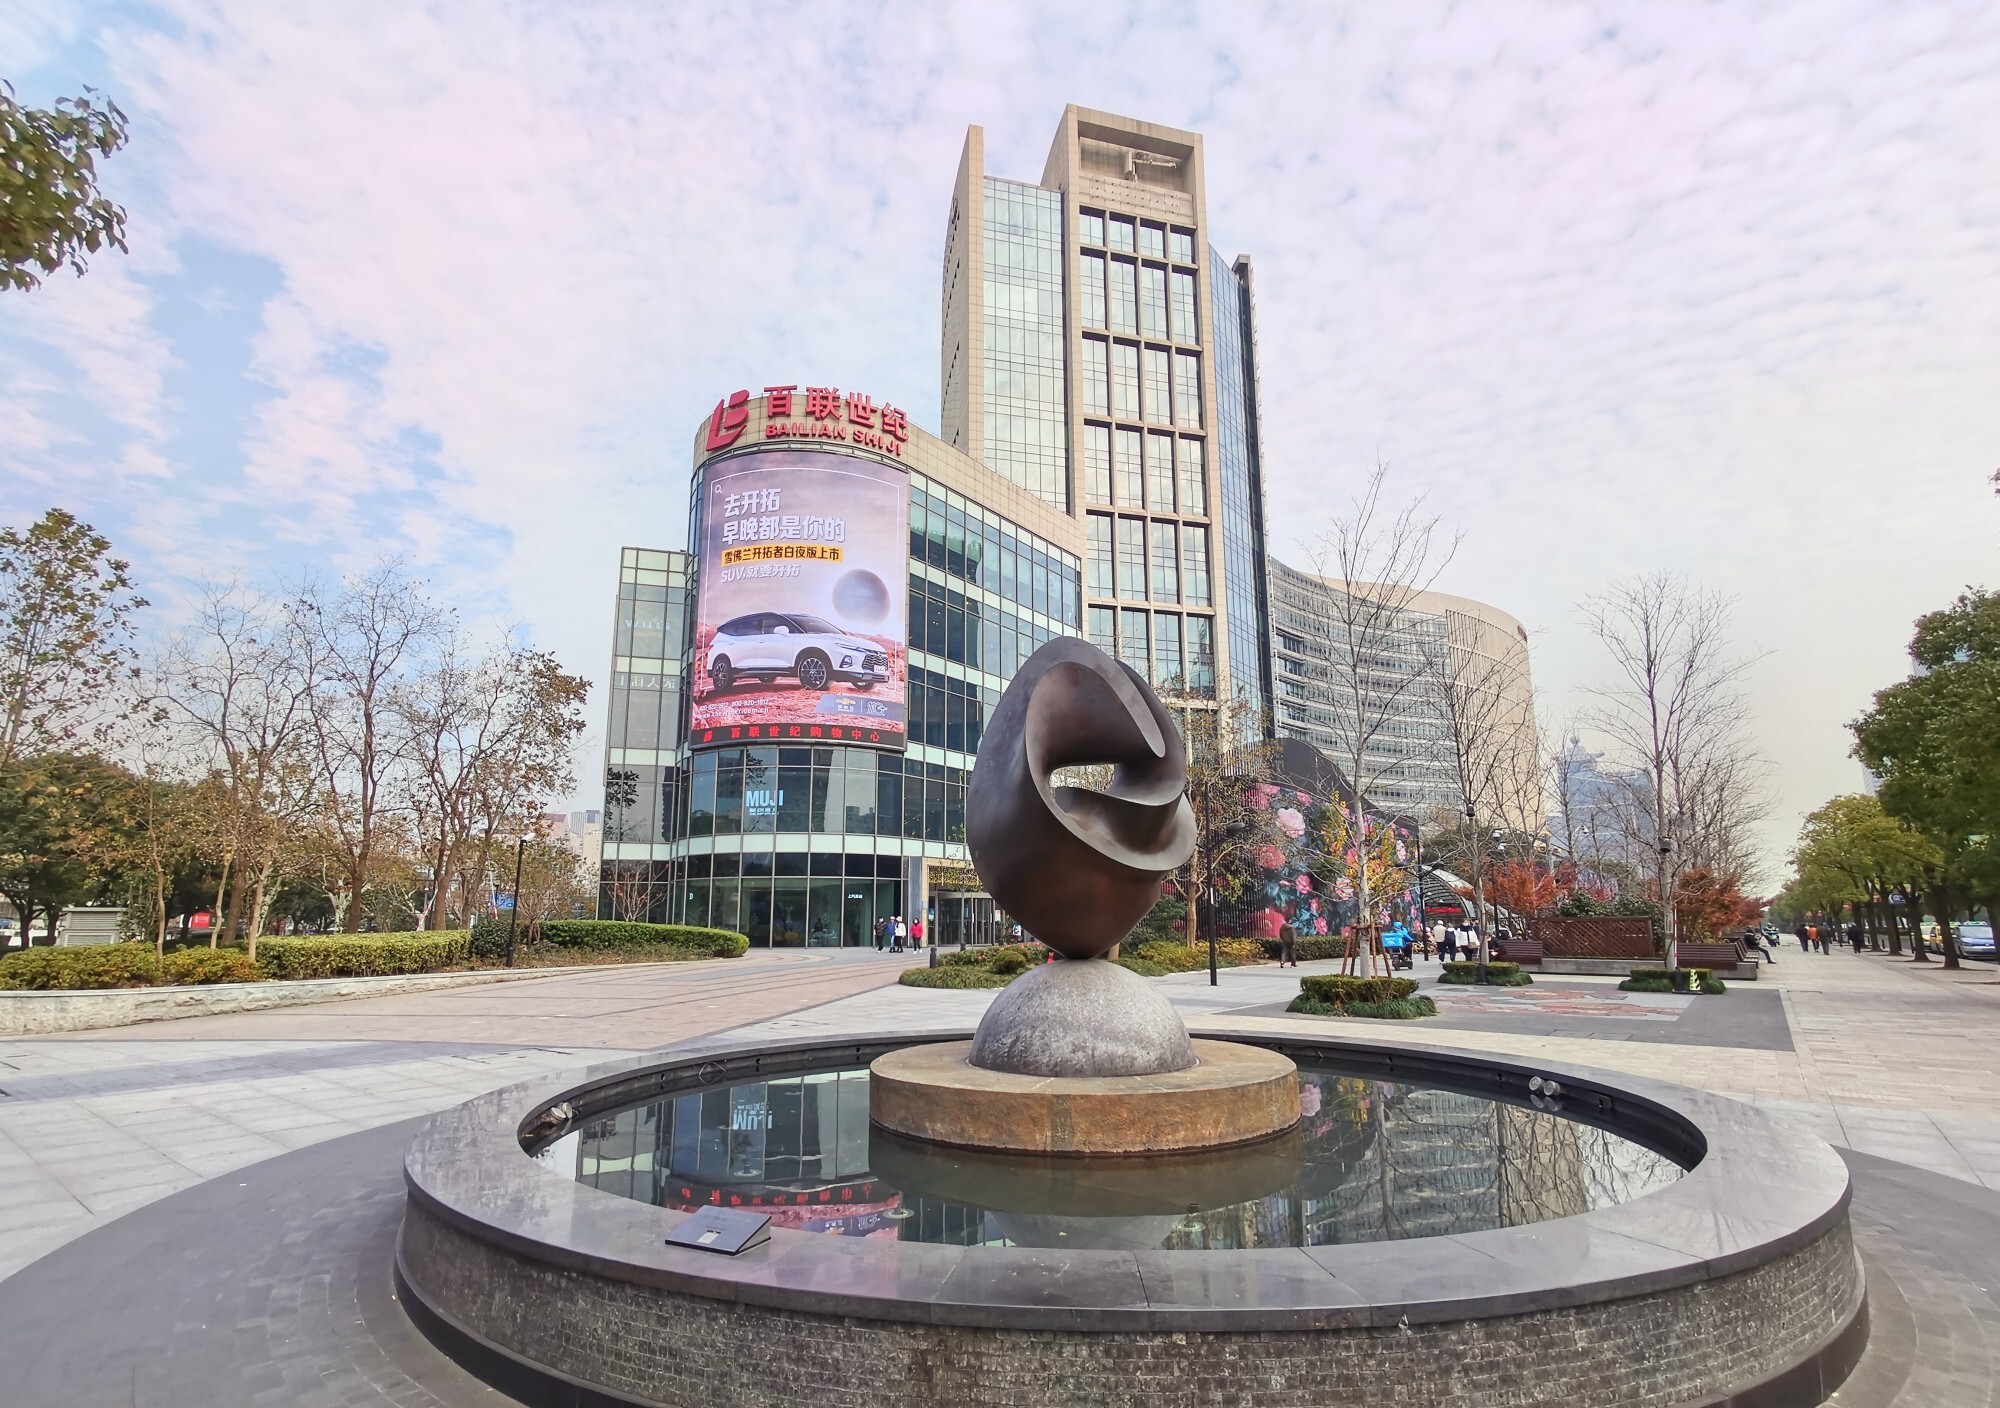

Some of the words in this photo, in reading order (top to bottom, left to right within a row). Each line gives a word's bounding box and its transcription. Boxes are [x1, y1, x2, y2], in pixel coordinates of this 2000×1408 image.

[763, 384, 909, 442] 百联世纪
[765, 422, 846, 440] BAILIAN
[724, 488, 782, 518] 去开拓
[721, 515, 846, 546] 早晚都是你的
[724, 546, 840, 565] 雪佛兰开拓者白夜版上市
[731, 725, 880, 742] 百联世纪购物中心
[746, 789, 784, 807] MUJI
